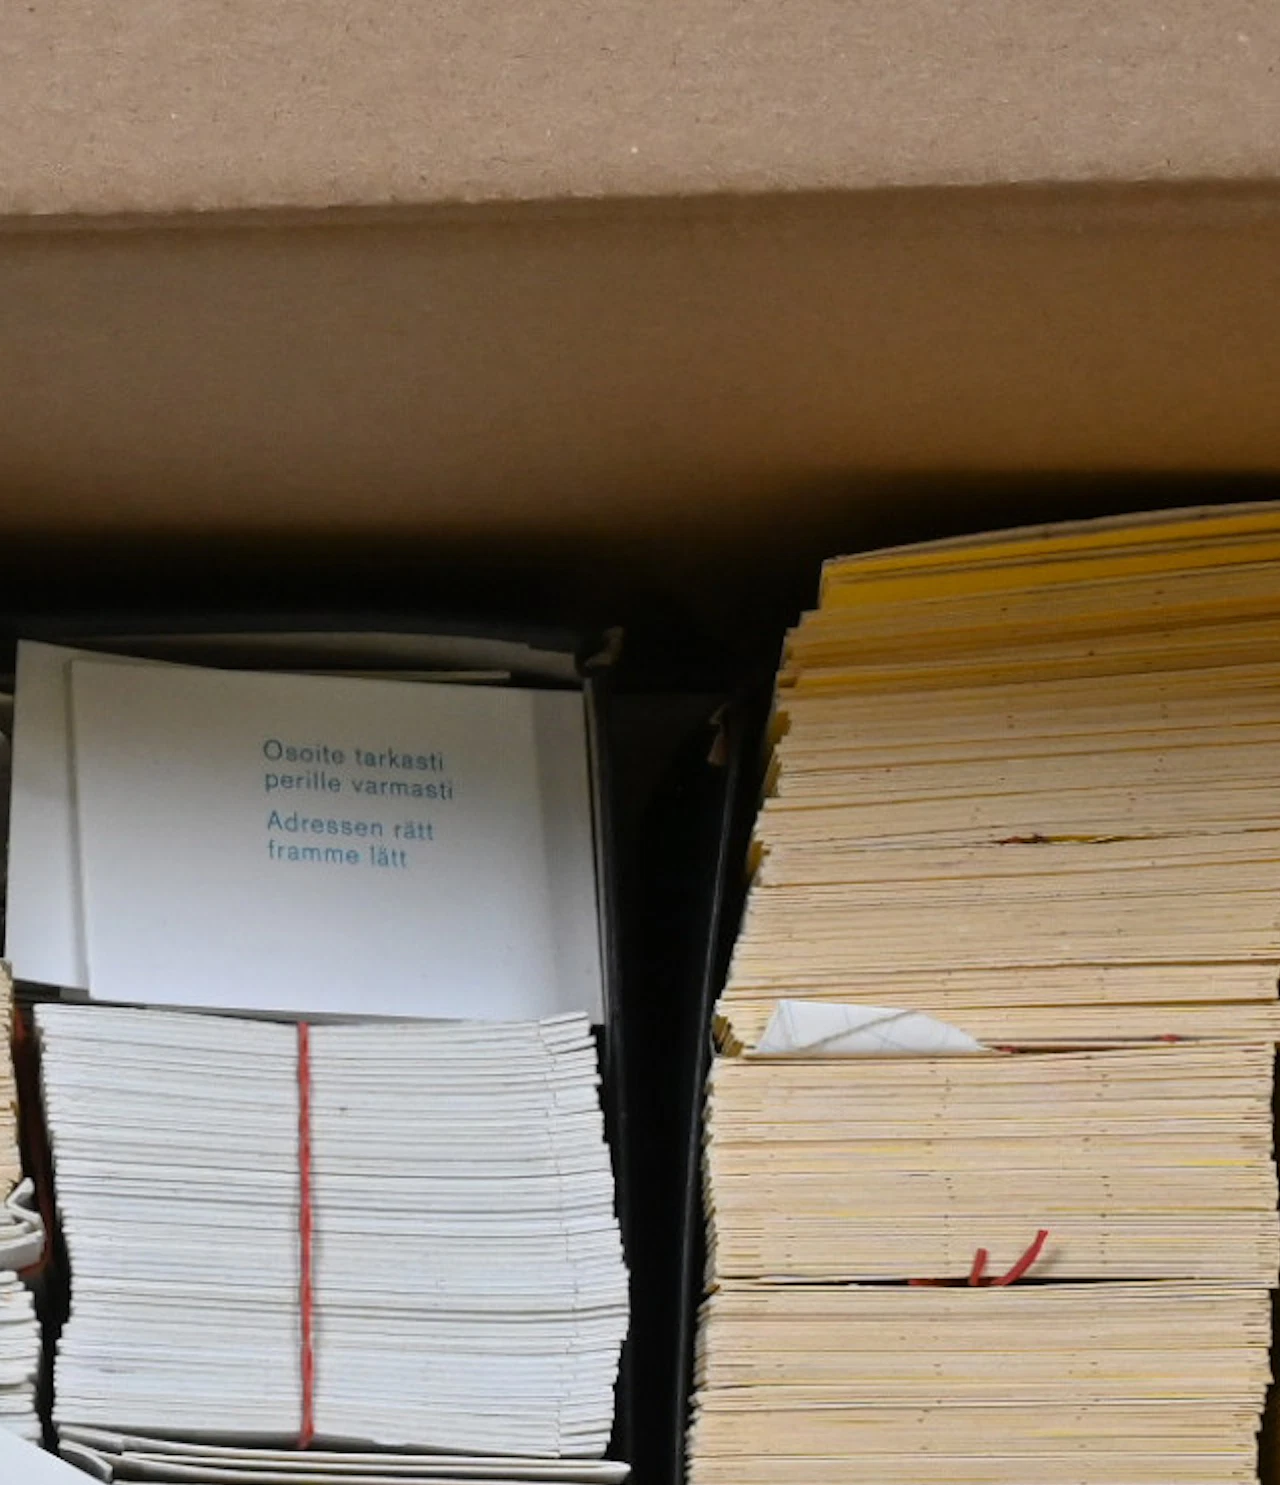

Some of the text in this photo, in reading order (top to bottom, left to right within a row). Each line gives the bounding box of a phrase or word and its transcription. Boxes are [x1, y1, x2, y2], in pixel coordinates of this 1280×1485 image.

[262, 738, 444, 774] Osoite tarkasti
[264, 768, 454, 801] perille varmasti
[267, 809, 434, 842] Adressen rätt
[267, 839, 408, 869] framme lätt
